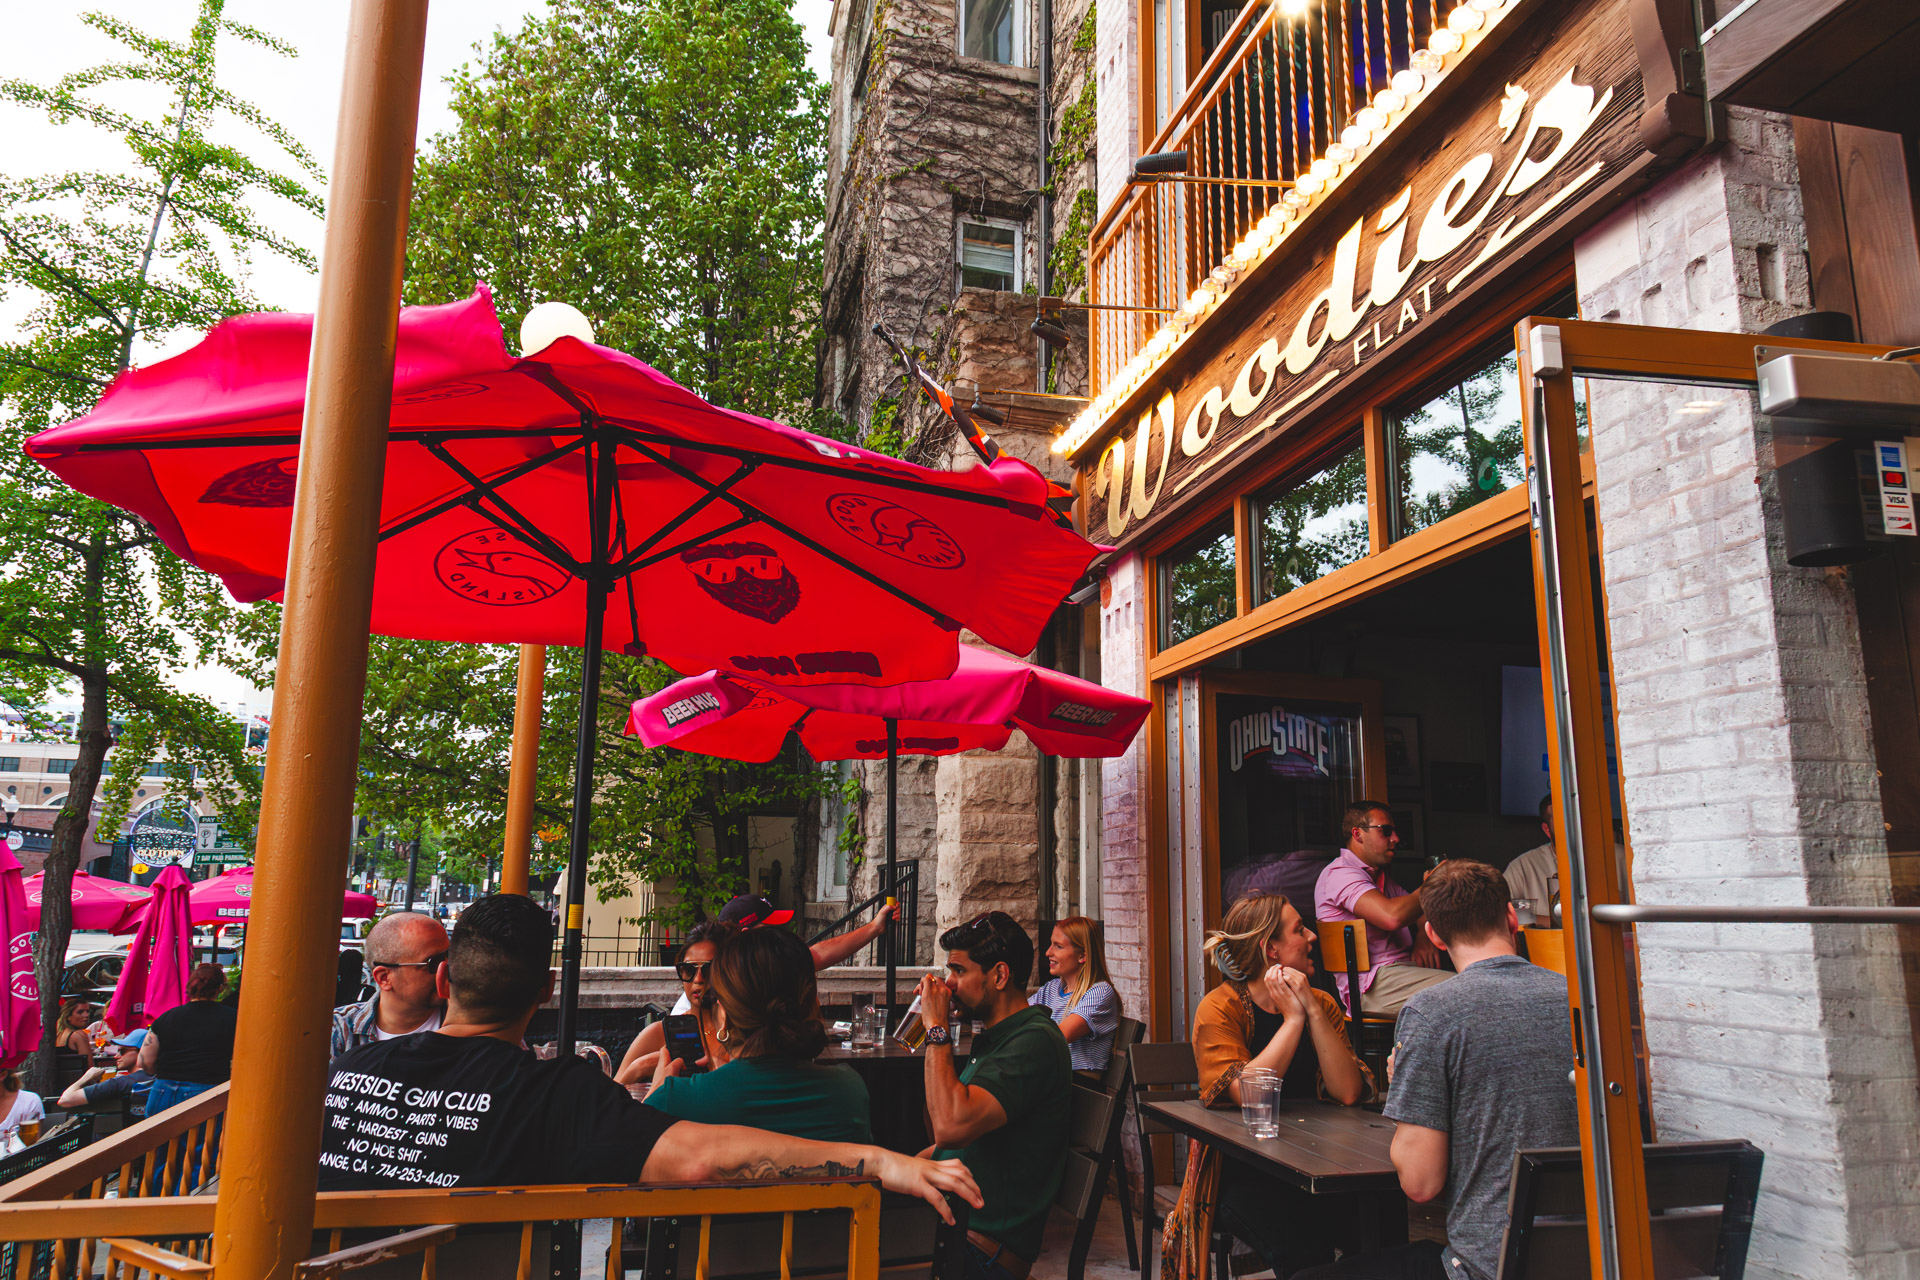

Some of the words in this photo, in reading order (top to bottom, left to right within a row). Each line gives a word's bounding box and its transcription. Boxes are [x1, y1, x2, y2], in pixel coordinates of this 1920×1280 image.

[1096, 65, 1614, 537] Woodie's
[1353, 276, 1436, 365] FLAT
[1887, 496, 1906, 504] VISA
[662, 698, 700, 728] BEER
[690, 691, 720, 713] HUG
[1050, 701, 1095, 723] BEER
[136, 849, 156, 857] OLD
[157, 849, 185, 857] TOWN
[330, 1070, 403, 1101] WESTSIDE
[404, 1087, 443, 1108] GUN
[445, 1091, 491, 1113] CLUB
[325, 1093, 349, 1110] GUNS
[354, 1100, 399, 1121] AMMO
[405, 1112, 437, 1127] PARTS
[445, 1114, 479, 1131] VIBES
[331, 1114, 350, 1131] THE
[356, 1119, 408, 1141] HARDEST
[415, 1131, 448, 1147] GUNS
[346, 1138, 370, 1153] NO
[370, 1142, 395, 1159] HOE
[397, 1147, 422, 1163] SHIT
[319, 1151, 350, 1171] ANGE,
[352, 1158, 367, 1173] CA
[375, 1163, 460, 1188] 714-253-4407
